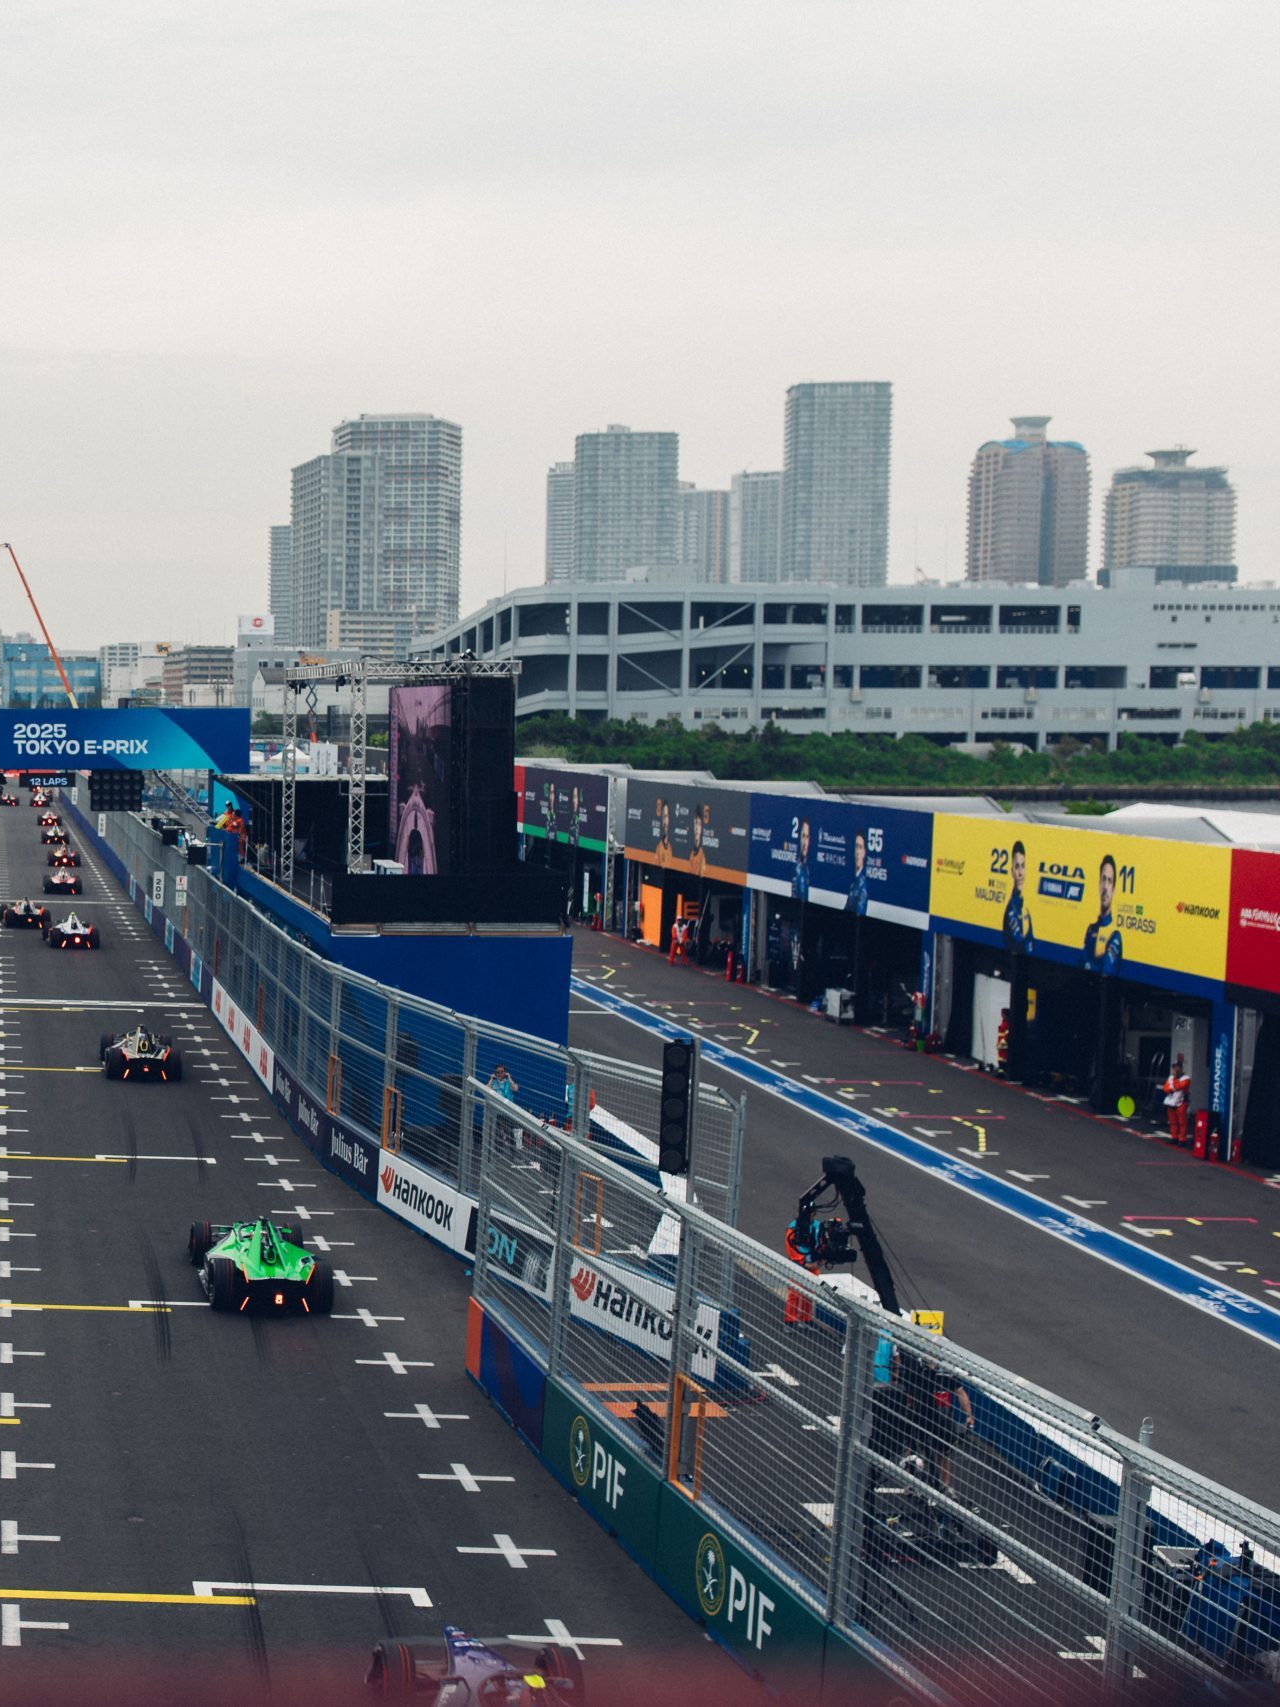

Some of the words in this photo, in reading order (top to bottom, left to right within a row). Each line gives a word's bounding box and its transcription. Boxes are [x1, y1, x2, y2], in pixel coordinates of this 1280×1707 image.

[14, 724, 67, 738] 2025
[13, 740, 80, 755] TOKYO
[84, 740, 149, 755] E-PRIX
[30, 778, 41, 786] 12
[44, 778, 68, 786] LAPS
[792, 816, 798, 838] 2
[868, 828, 884, 852] 55
[990, 848, 1009, 874] 22
[1039, 862, 1085, 880] LOLA
[866, 866, 888, 881] HUGHES
[1120, 866, 1135, 894] 11
[975, 887, 1006, 904] MALONEY
[1126, 916, 1156, 934] GRASSI
[298, 1095, 310, 1128] Julius
[331, 1128, 353, 1164] Julius
[353, 1142, 368, 1175] Bär
[592, 1440, 626, 1510] PIF
[728, 1565, 776, 1650] PIF
